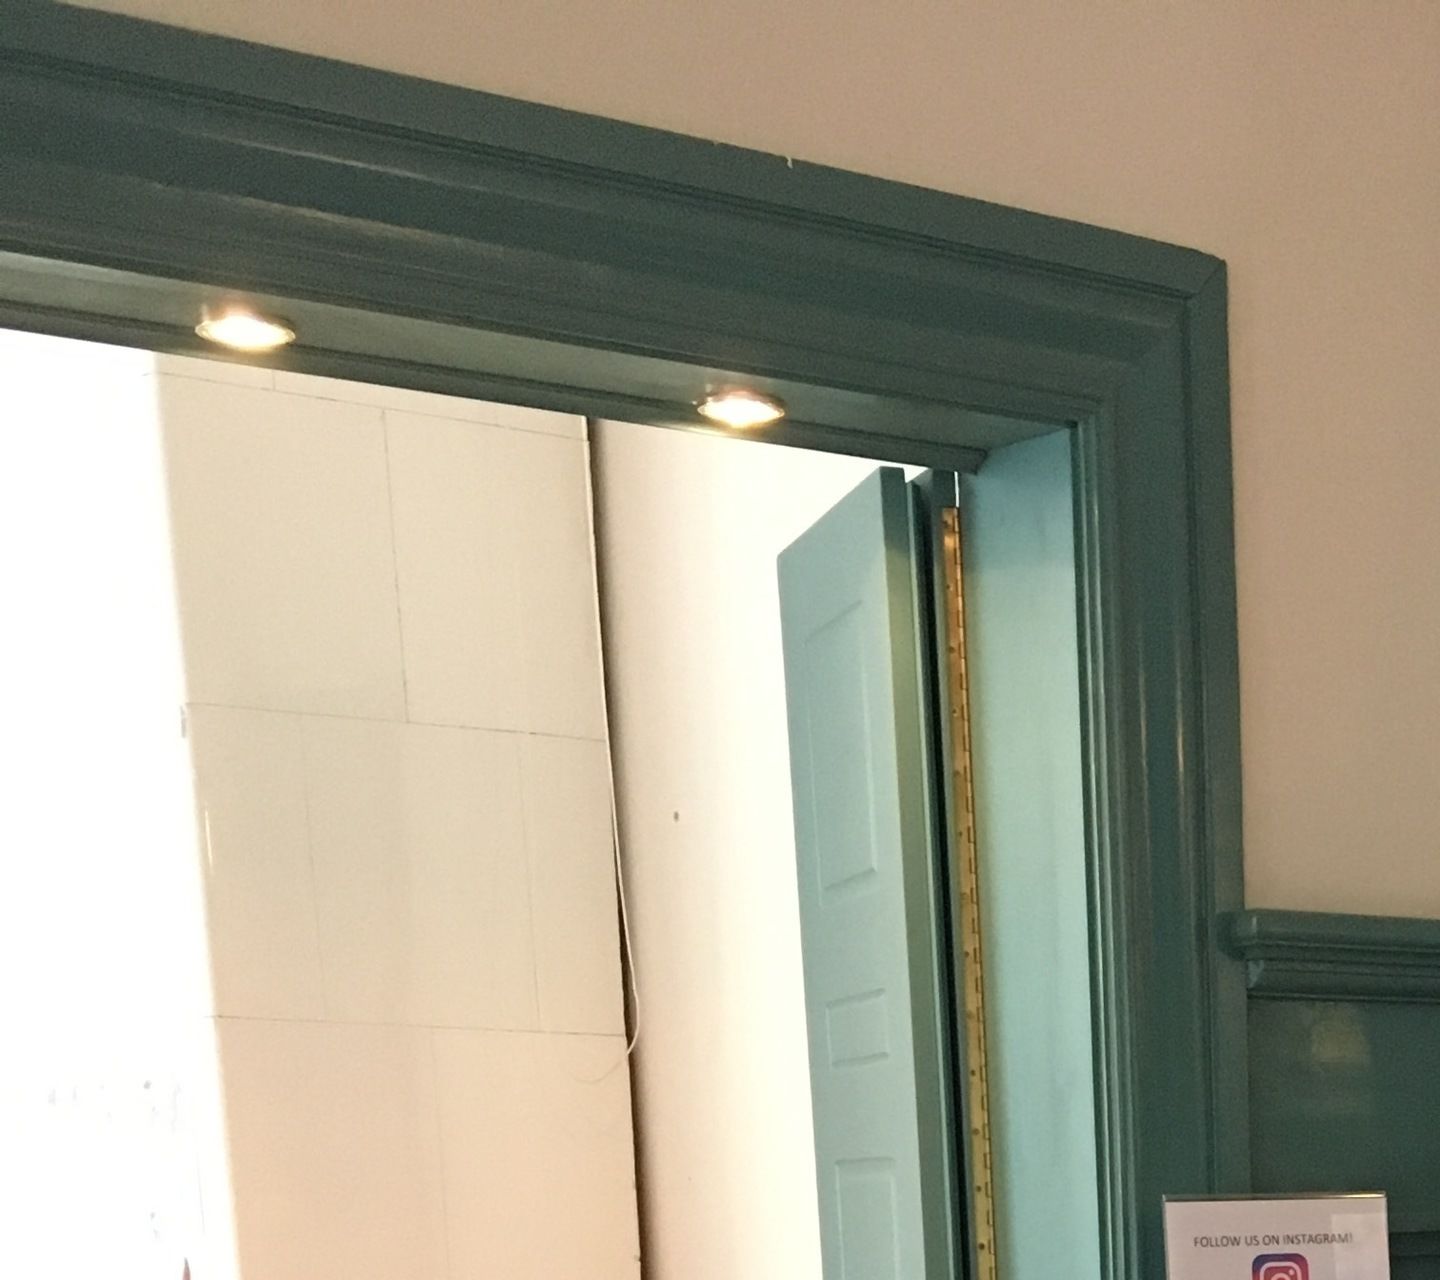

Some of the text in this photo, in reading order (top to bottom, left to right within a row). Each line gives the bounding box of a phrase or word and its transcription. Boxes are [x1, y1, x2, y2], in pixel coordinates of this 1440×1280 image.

[1193, 1232, 1353, 1248] FOLLOW US ON INSTAGRAM!
